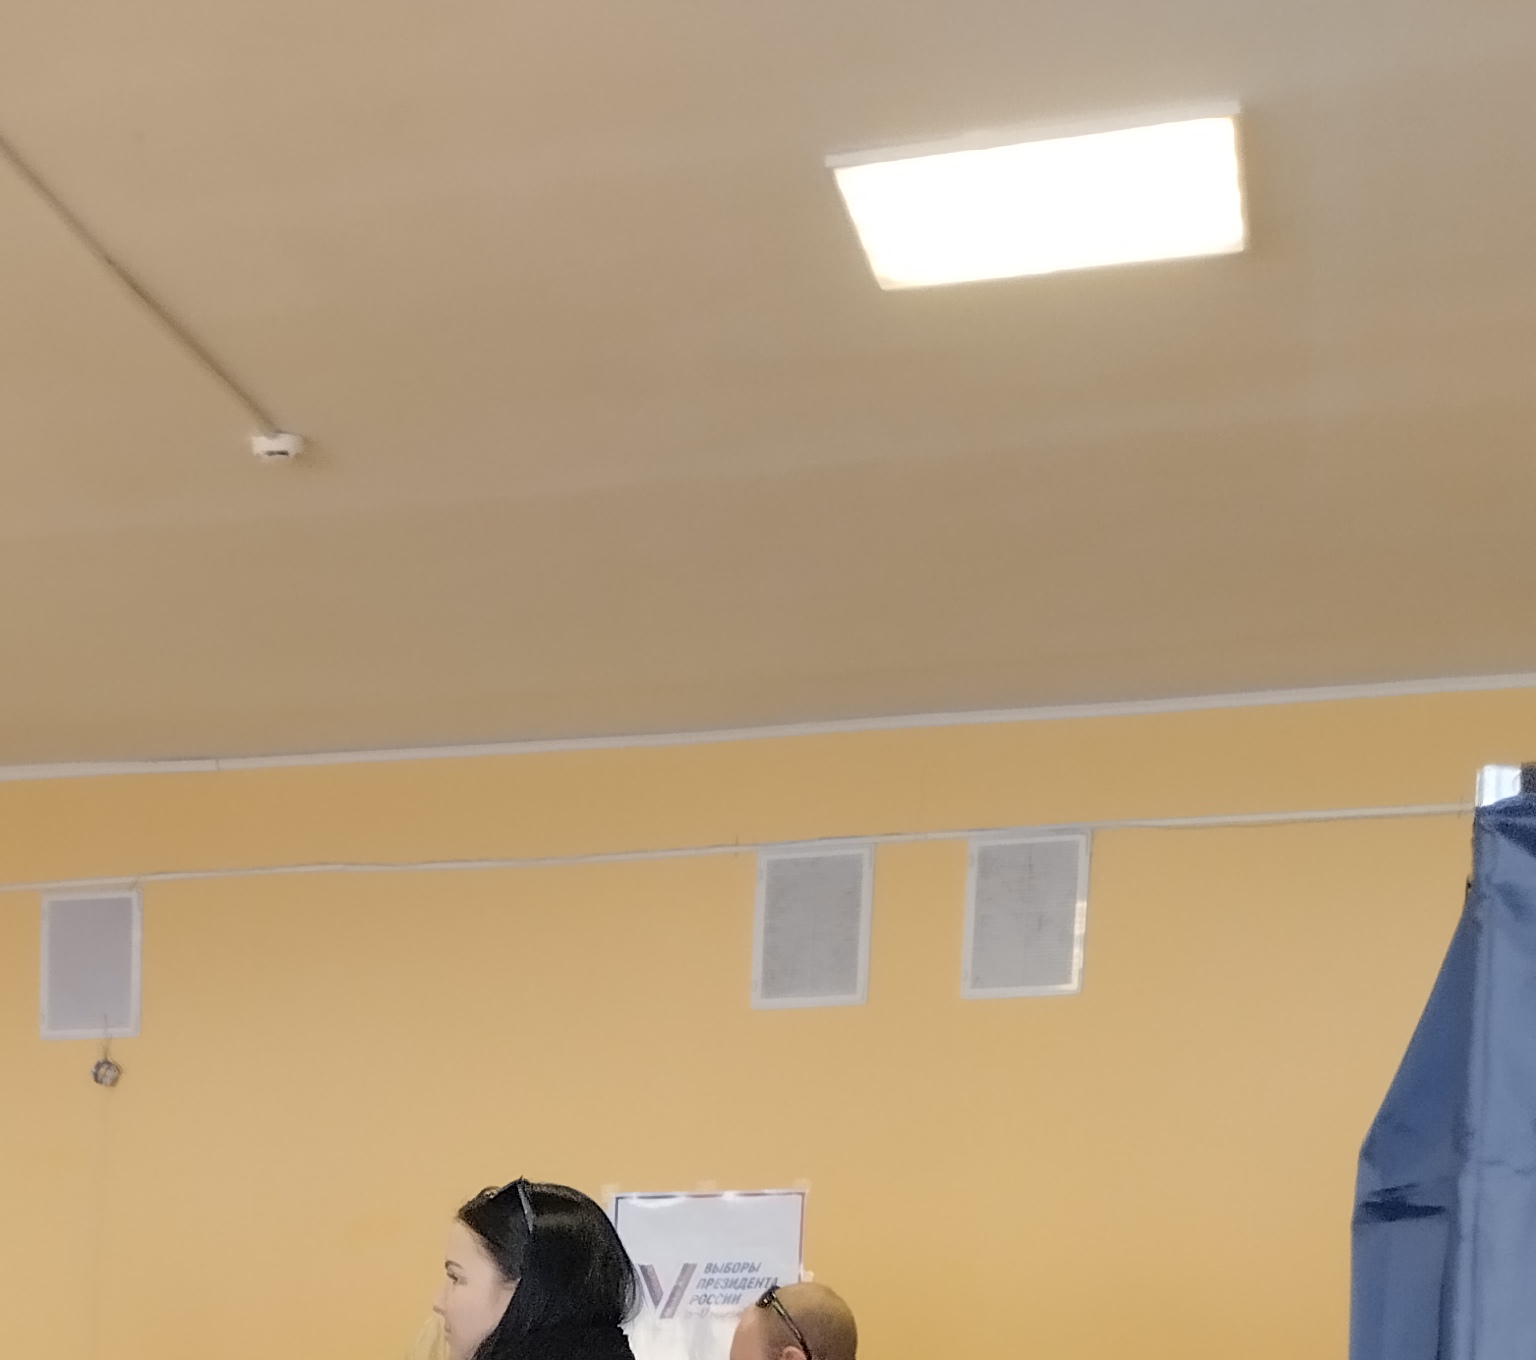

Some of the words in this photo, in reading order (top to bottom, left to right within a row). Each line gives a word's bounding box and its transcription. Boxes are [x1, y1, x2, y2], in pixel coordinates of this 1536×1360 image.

[703, 1261, 762, 1275] ВЫБОРЫ
[695, 1276, 779, 1291] ПРЕЗИДЕНТА
[688, 1293, 743, 1306] РОССИИ
